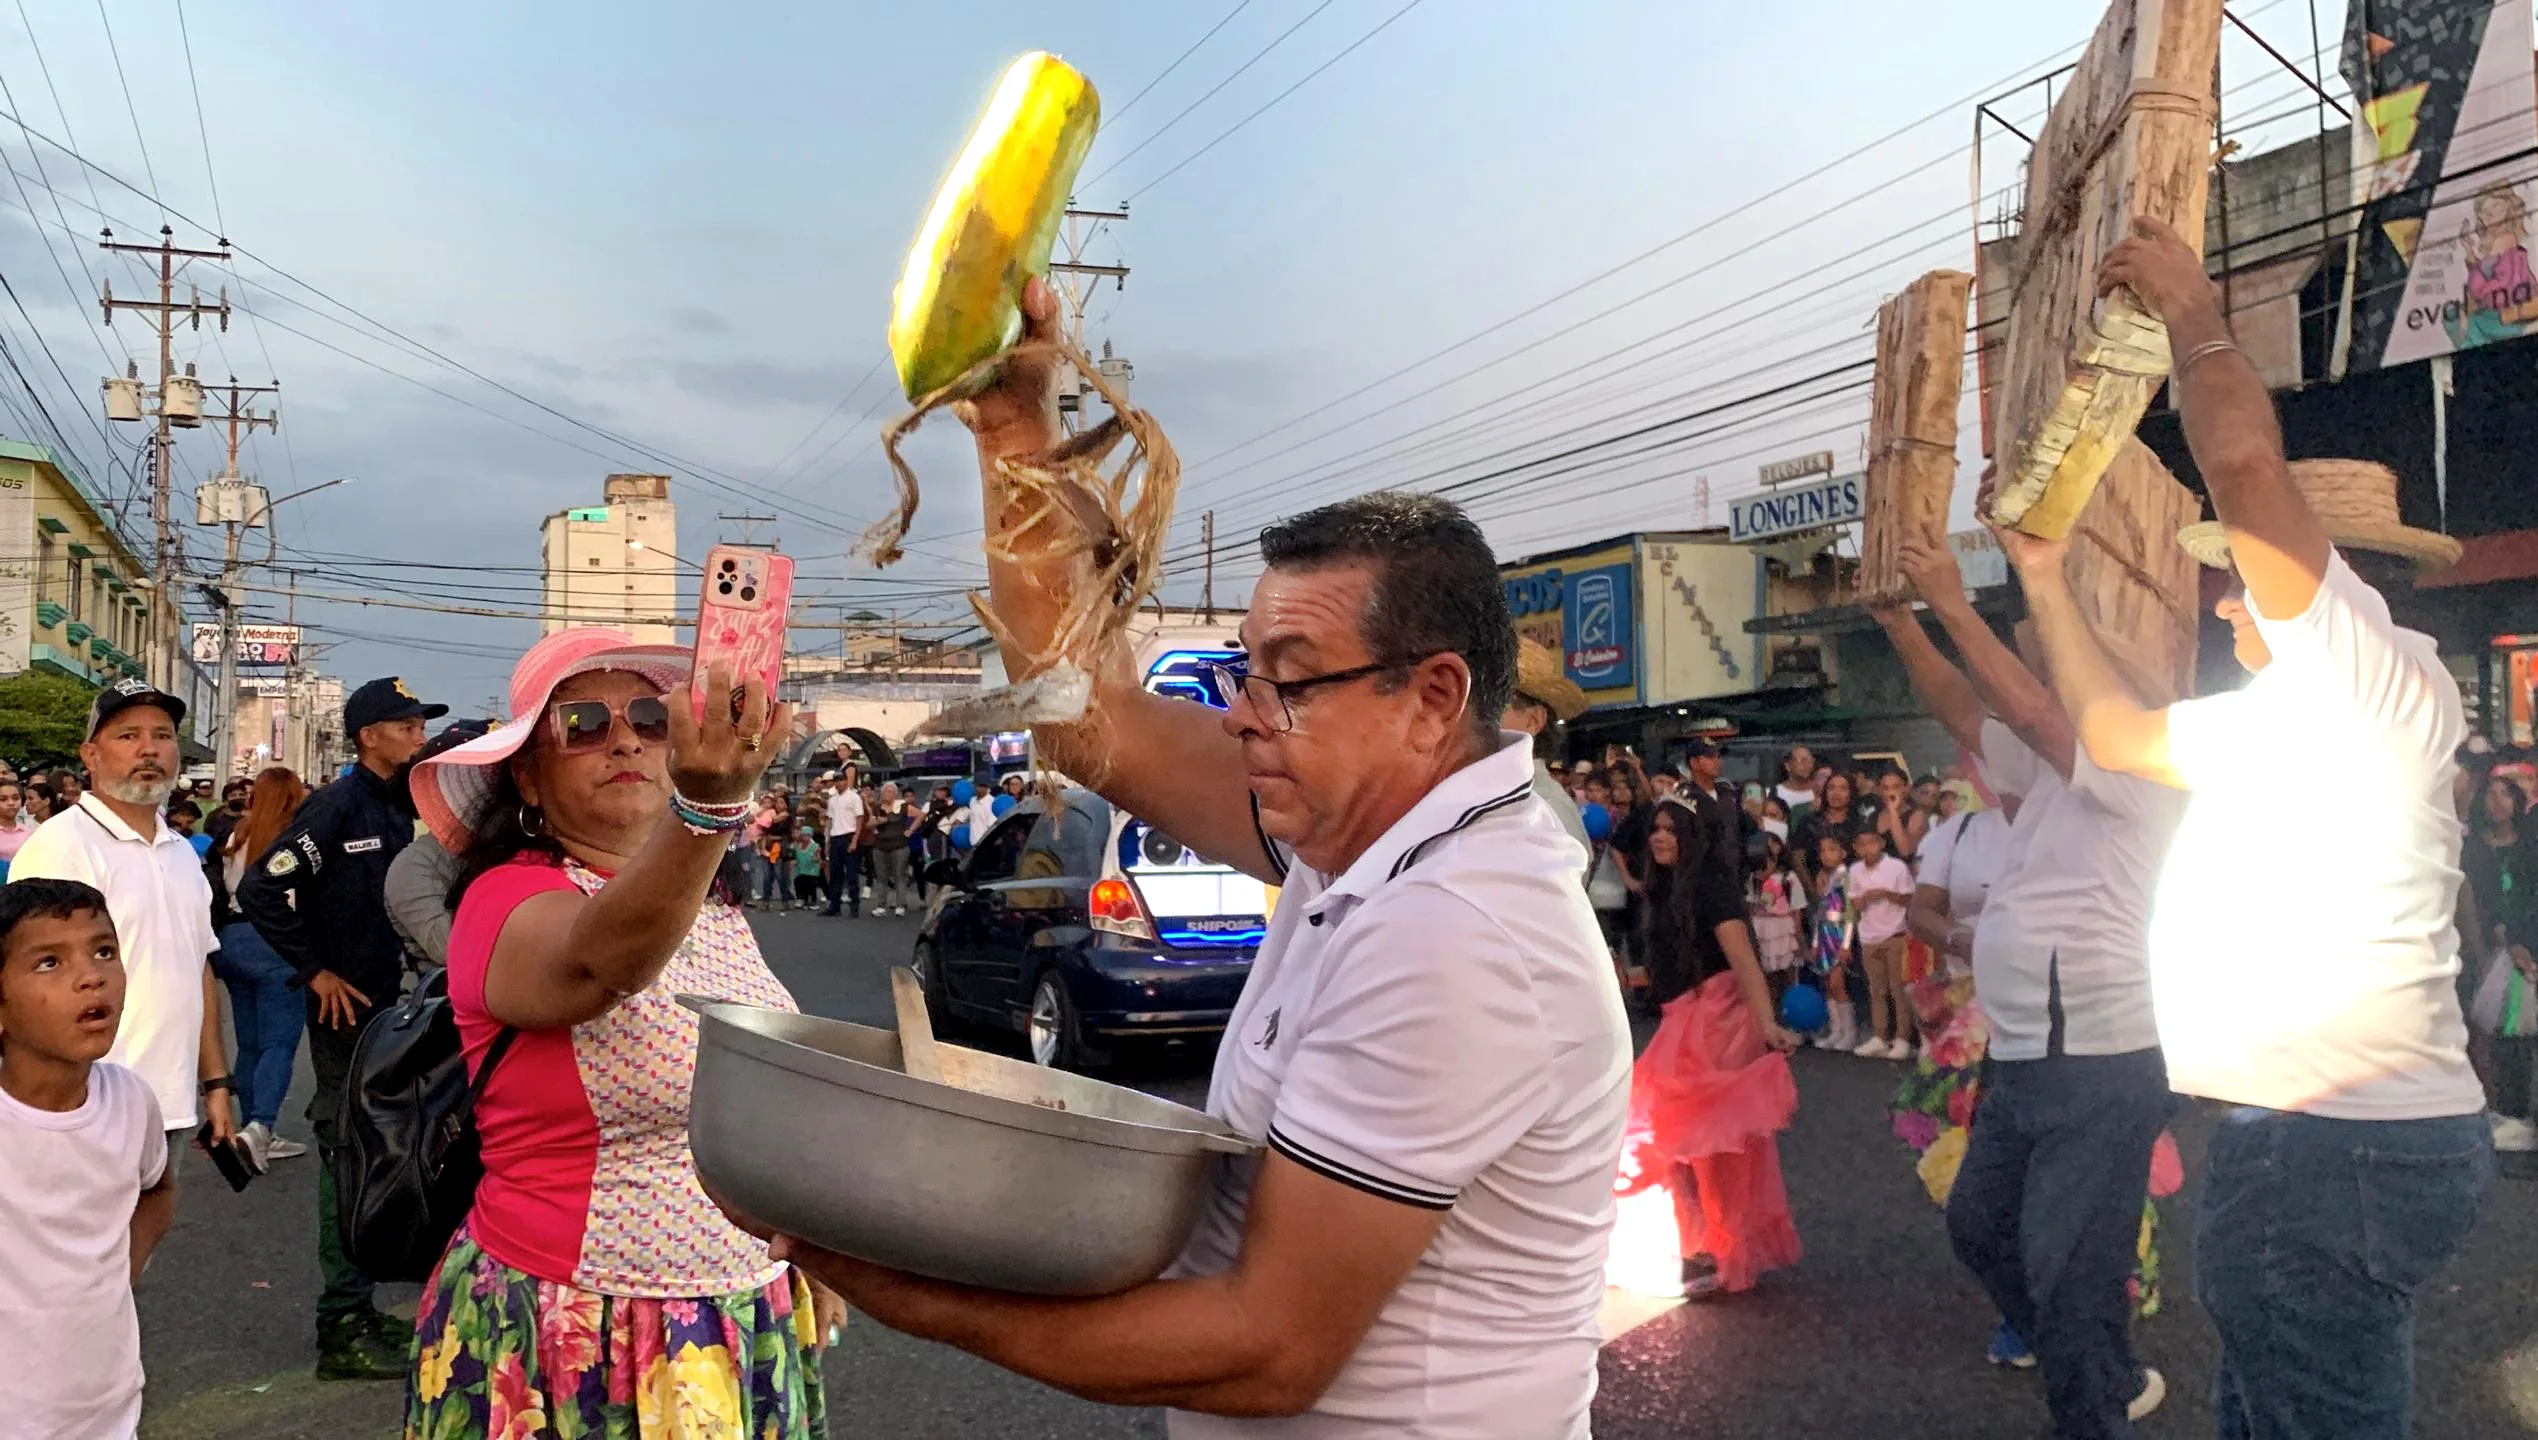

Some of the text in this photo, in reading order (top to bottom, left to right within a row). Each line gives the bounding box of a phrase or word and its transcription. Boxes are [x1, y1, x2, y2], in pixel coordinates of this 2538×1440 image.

[2407, 282, 2531, 332] evalna
[1733, 481, 1859, 538] LONGINES
[1501, 568, 1563, 617] COS
